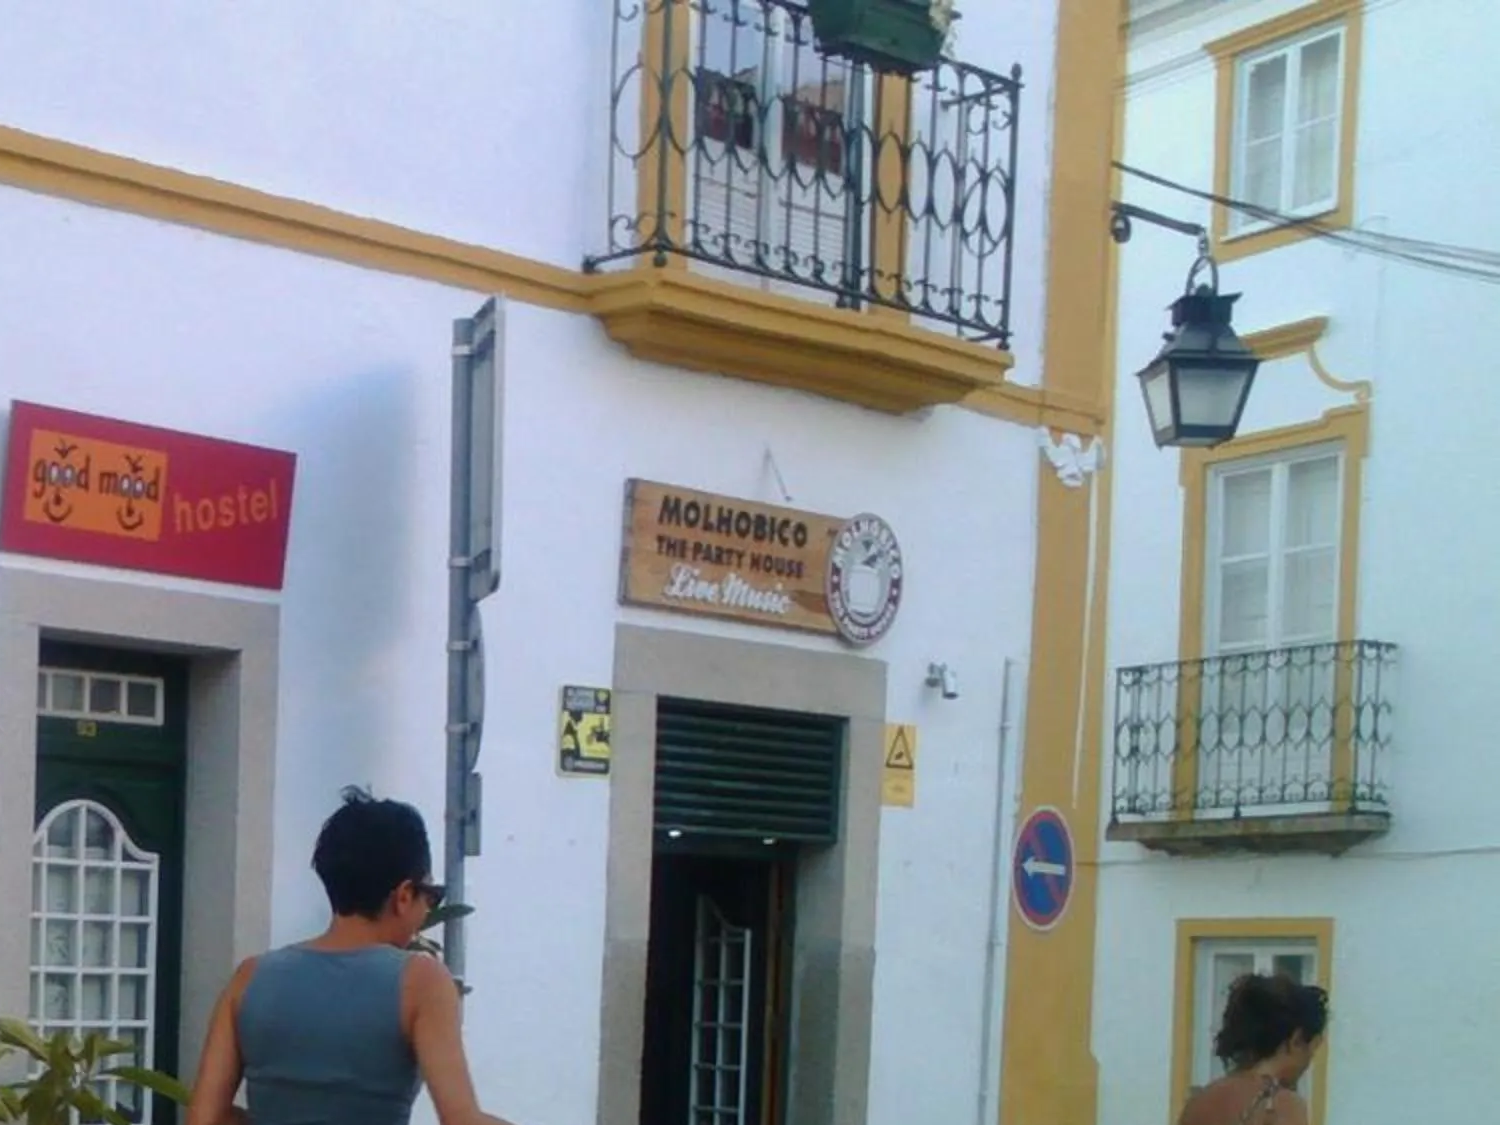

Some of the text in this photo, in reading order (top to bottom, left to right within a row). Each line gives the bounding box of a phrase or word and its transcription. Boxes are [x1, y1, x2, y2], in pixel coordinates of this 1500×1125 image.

[32, 454, 278, 532] good mood hostel
[657, 494, 808, 548] MOLHOBICO
[656, 535, 804, 578] THE PARTY HOUSE
[722, 572, 793, 614] Music
